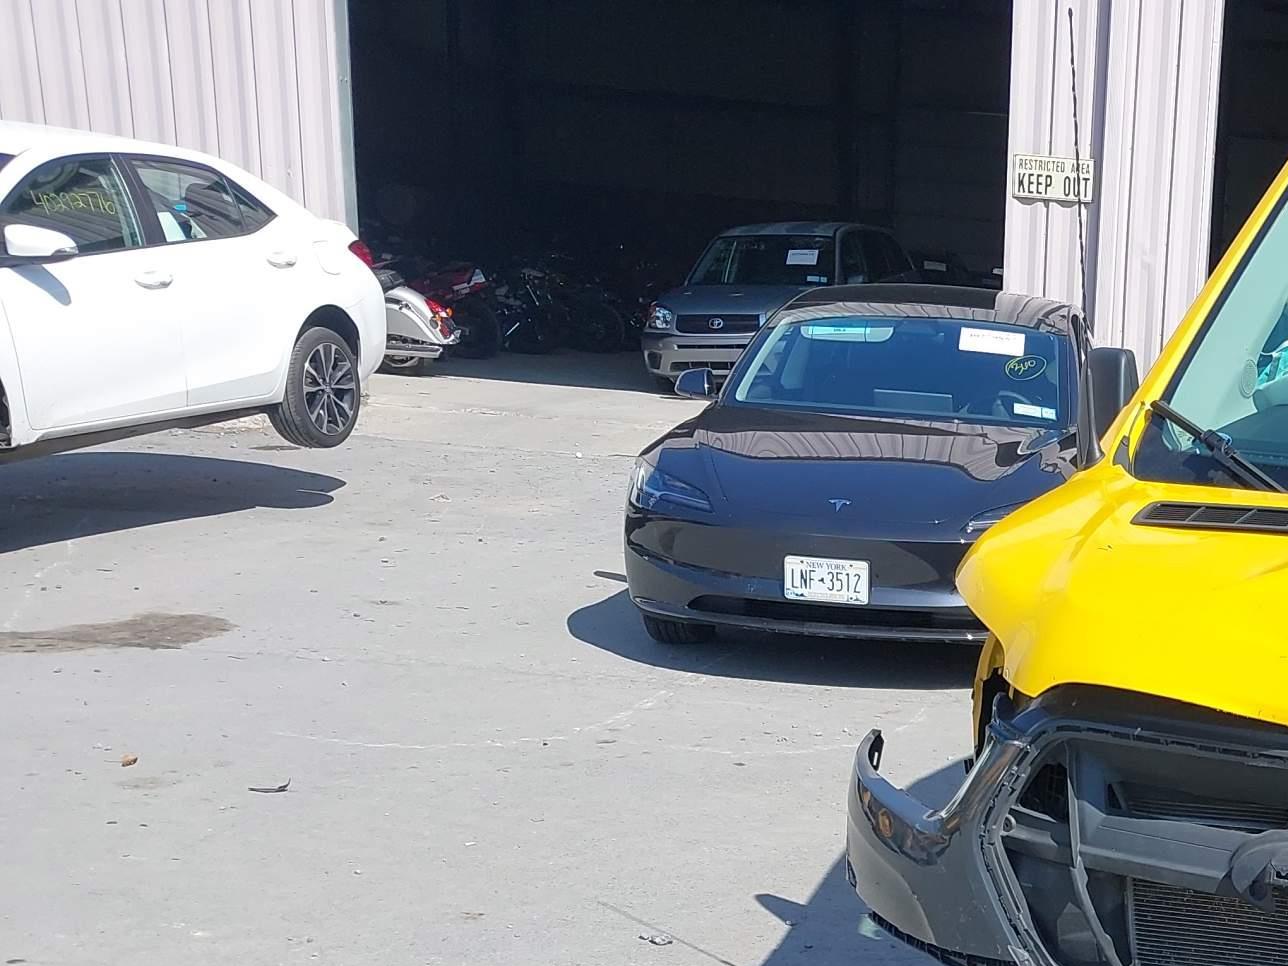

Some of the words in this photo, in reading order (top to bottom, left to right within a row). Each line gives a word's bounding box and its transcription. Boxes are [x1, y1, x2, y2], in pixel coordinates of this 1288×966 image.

[1018, 158, 1066, 173] RESTRICTED
[1070, 162, 1091, 175] AEA
[1017, 172, 1053, 195] KEEP
[1063, 175, 1091, 198] OUT
[805, 561, 825, 570] NEW
[826, 562, 847, 571] YORK
